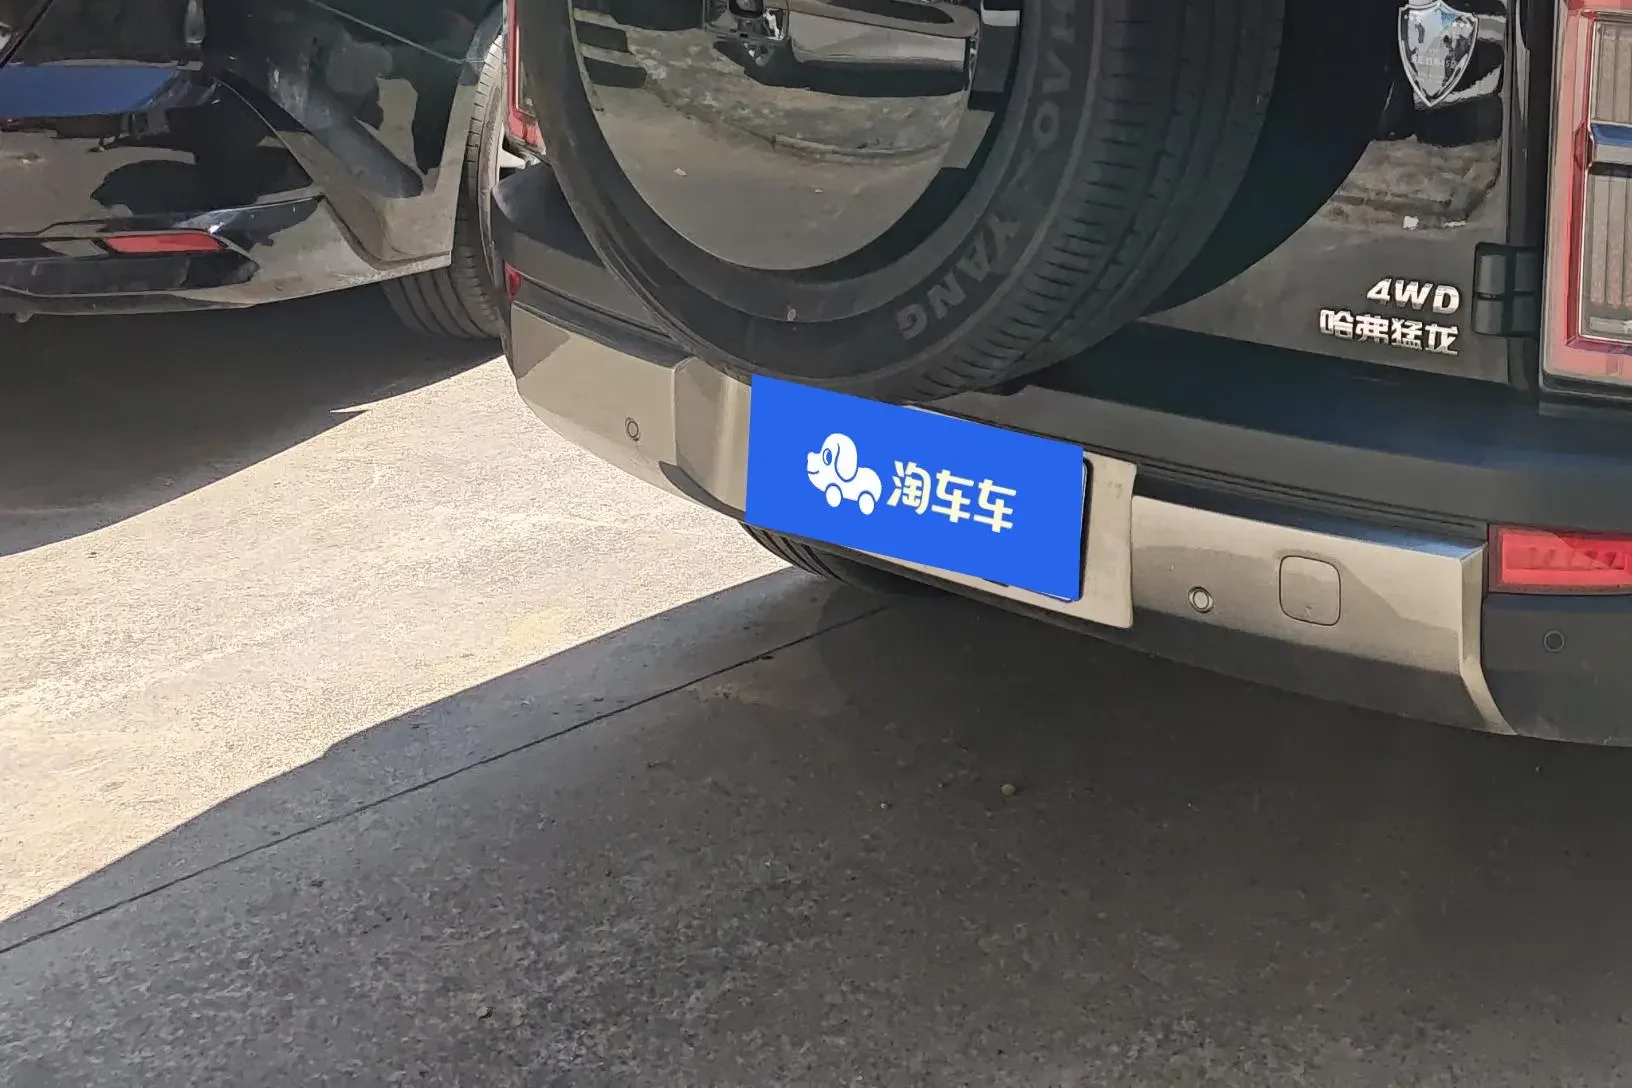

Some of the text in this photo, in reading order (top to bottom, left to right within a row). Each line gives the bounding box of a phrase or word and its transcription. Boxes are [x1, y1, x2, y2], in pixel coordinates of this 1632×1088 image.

[1367, 278, 1460, 314] 4WD
[1319, 309, 1459, 356] 哈弗猛龙
